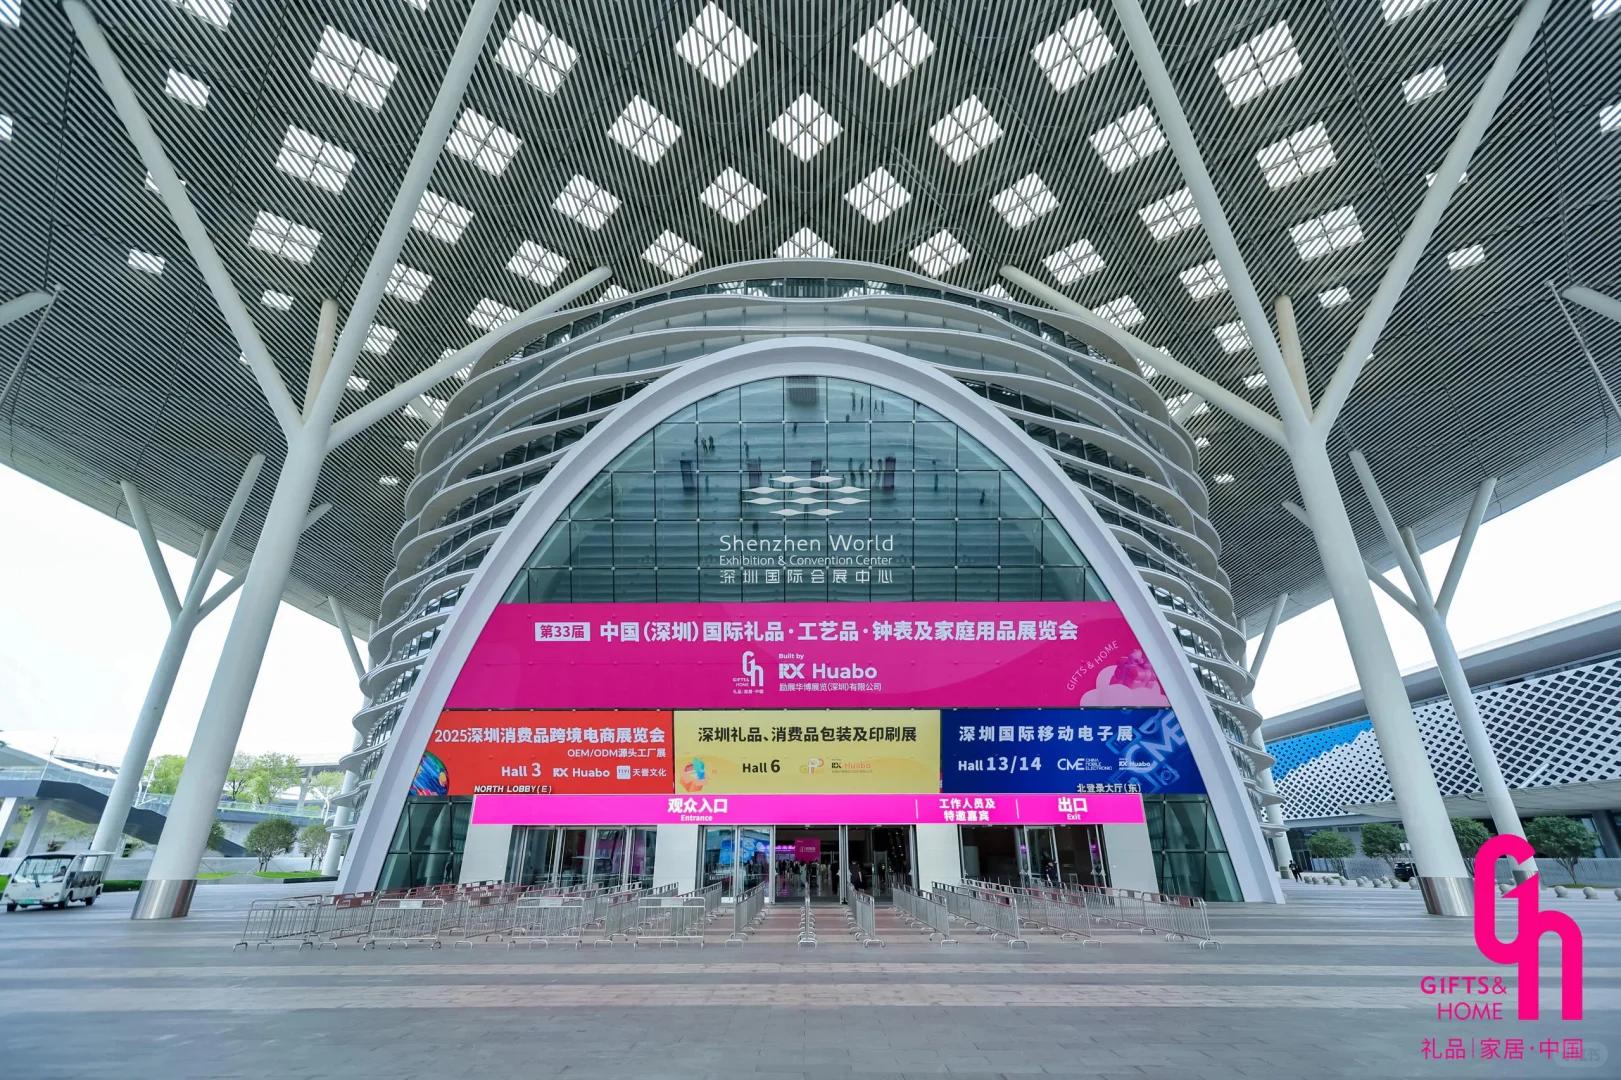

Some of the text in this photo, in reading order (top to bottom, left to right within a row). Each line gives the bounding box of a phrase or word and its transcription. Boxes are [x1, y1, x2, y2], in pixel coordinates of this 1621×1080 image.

[719, 534, 894, 552] Shenzhen World
[719, 555, 893, 566] Exhibition & Convention Center
[719, 569, 893, 584] 深圳国际会展中心
[540, 624, 585, 639] 第33届
[795, 653, 805, 661] by
[778, 663, 878, 679] RX Huabo
[1066, 640, 1120, 691] GIFTS & HOME
[434, 727, 666, 744] 2025深圳消费品跨境电商展览会
[698, 726, 917, 742] 深圳礼品、消费品包装及印刷展
[958, 725, 1134, 742] 深圳国际移动电子展
[567, 748, 667, 758] OEM/ODM源头工厂展
[501, 762, 542, 777] Hall 3
[742, 759, 781, 773] Hall 6
[958, 757, 1042, 773] Hall 13/14
[1057, 758, 1086, 771] CME
[552, 767, 611, 778] RX Huabo
[474, 785, 504, 793] NORTH
[667, 797, 728, 814] 观众入口
[939, 798, 996, 810] 工作人员及
[1057, 796, 1088, 813] 出口
[680, 814, 713, 822] Entrance
[943, 810, 990, 822] 特邀嘉宾
[1066, 813, 1081, 821] Exit
